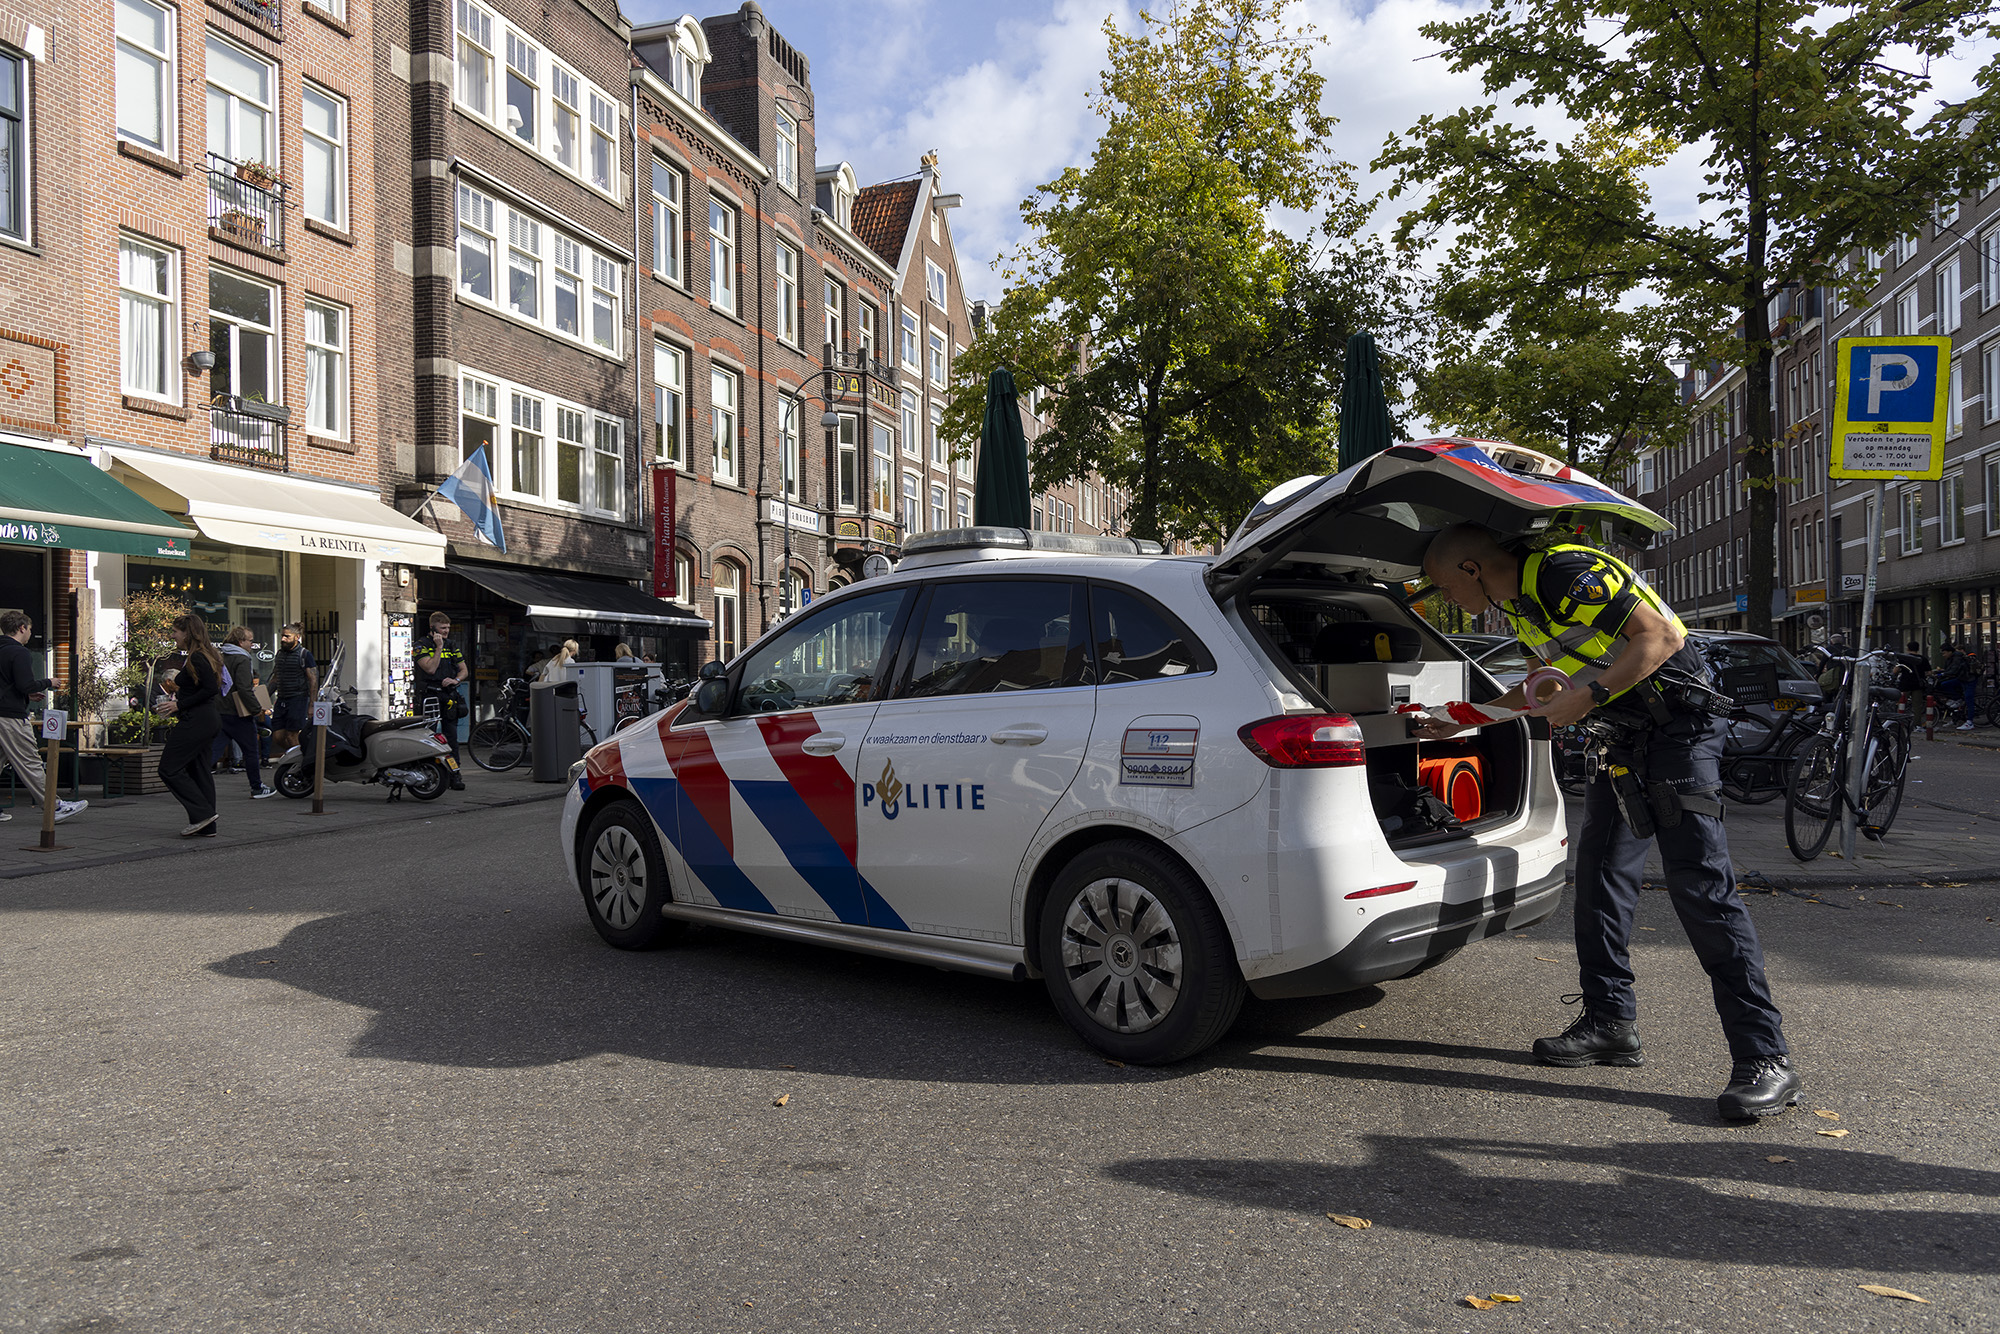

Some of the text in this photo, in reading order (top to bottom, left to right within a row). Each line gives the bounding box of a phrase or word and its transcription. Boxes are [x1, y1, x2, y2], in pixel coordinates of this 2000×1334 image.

[1867, 353, 1919, 414] P
[1877, 444, 1911, 452] maandag
[1896, 436, 1930, 444] parkeren
[771, 504, 816, 525] Pianlamuseum
[20, 524, 38, 541] Vis
[661, 505, 670, 547] Pianola
[157, 547, 187, 556] Heineken
[300, 535, 367, 553] LA REINITA
[1844, 576, 1861, 588] Etos
[804, 591, 810, 605] P
[863, 783, 985, 820] POLITIE
